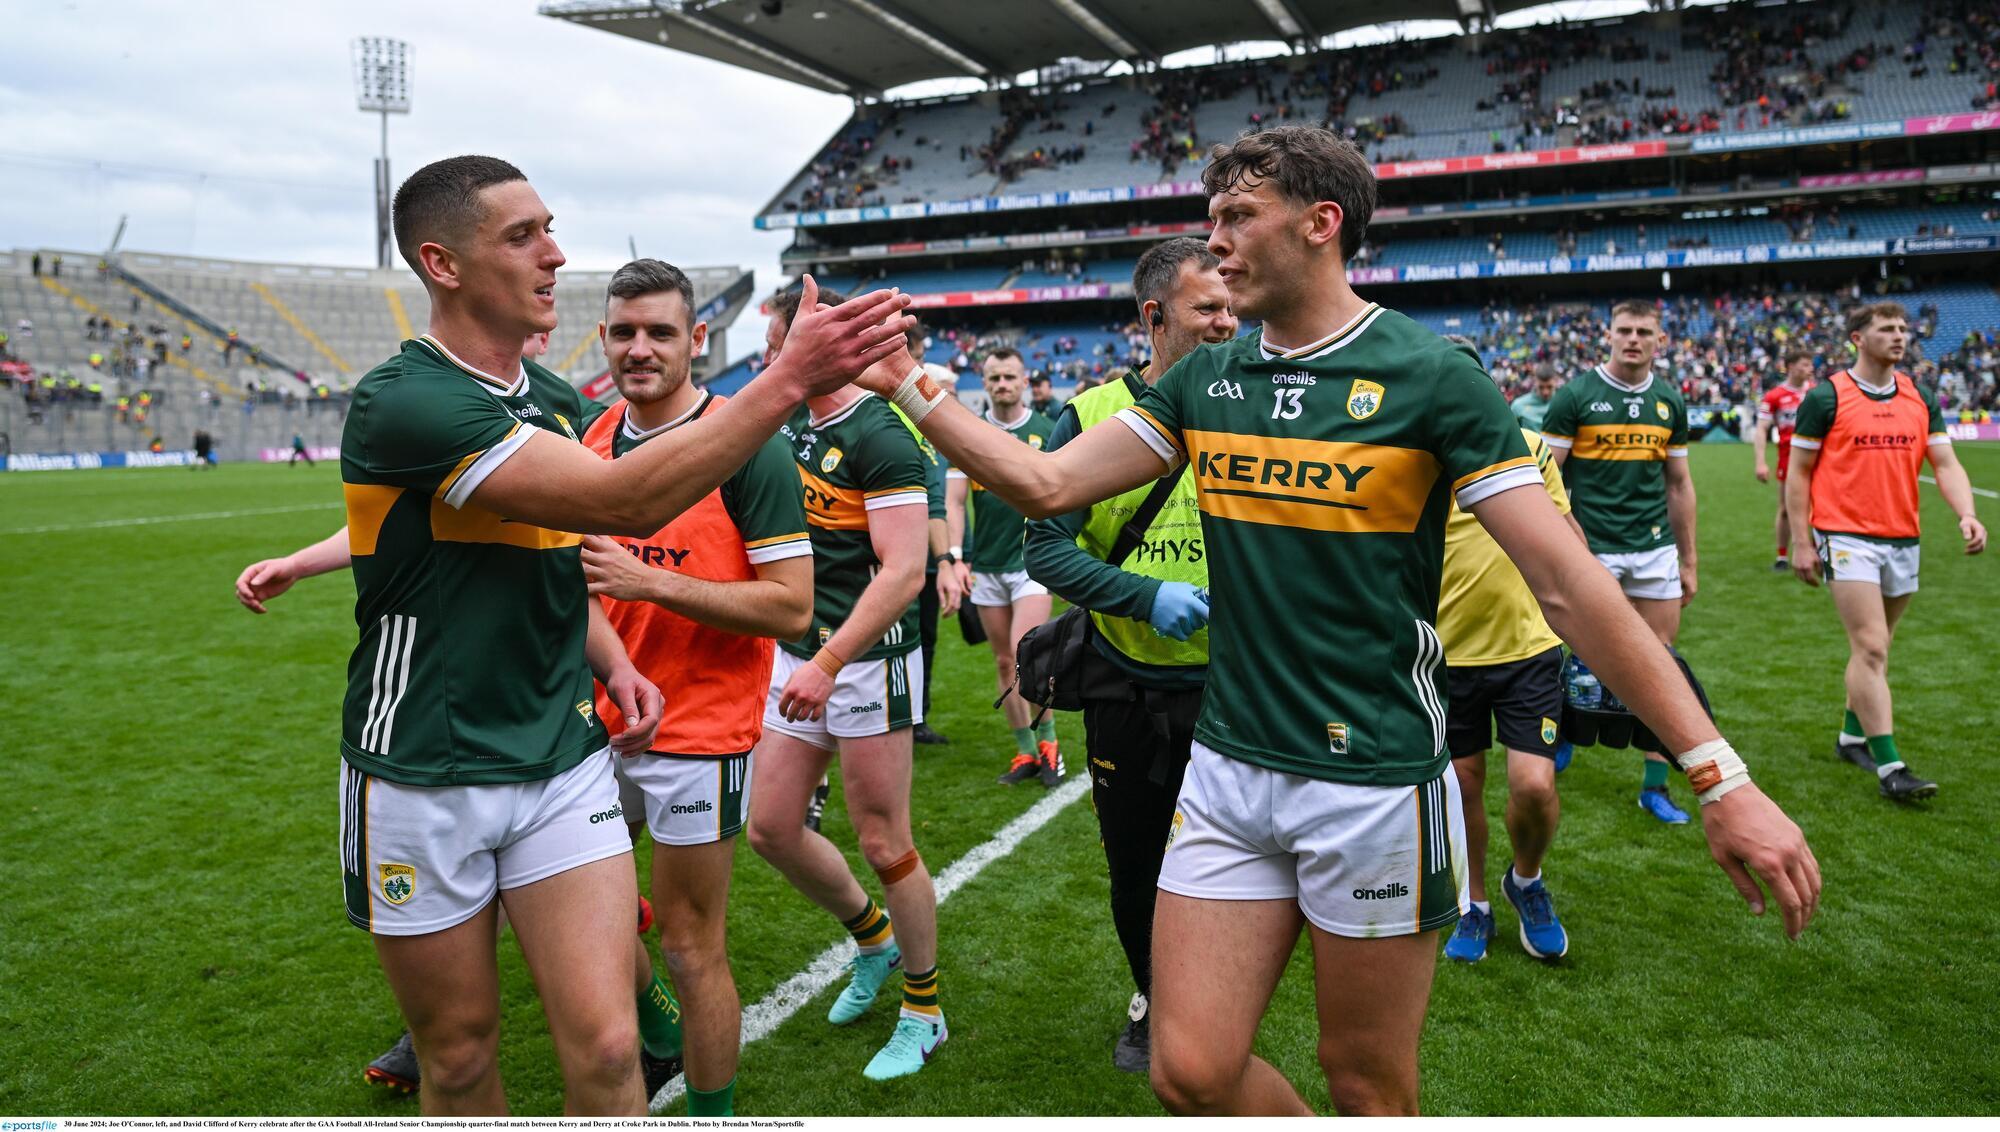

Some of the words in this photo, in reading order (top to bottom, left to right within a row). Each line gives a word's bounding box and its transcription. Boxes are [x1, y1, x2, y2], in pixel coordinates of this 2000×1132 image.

[1586, 254, 1643, 271] Allianz
[1683, 247, 1744, 266] Allianz
[1370, 268, 1393, 282] AIB
[1404, 264, 1456, 281] Allianz
[1493, 259, 1548, 276] Allianz
[1271, 388, 1306, 420] 13
[1629, 404, 1640, 419] 8
[1854, 434, 1916, 446] KERRY
[7, 453, 74, 471] Allianz
[1199, 451, 1375, 492] KERRY
[620, 543, 691, 567] RRY
